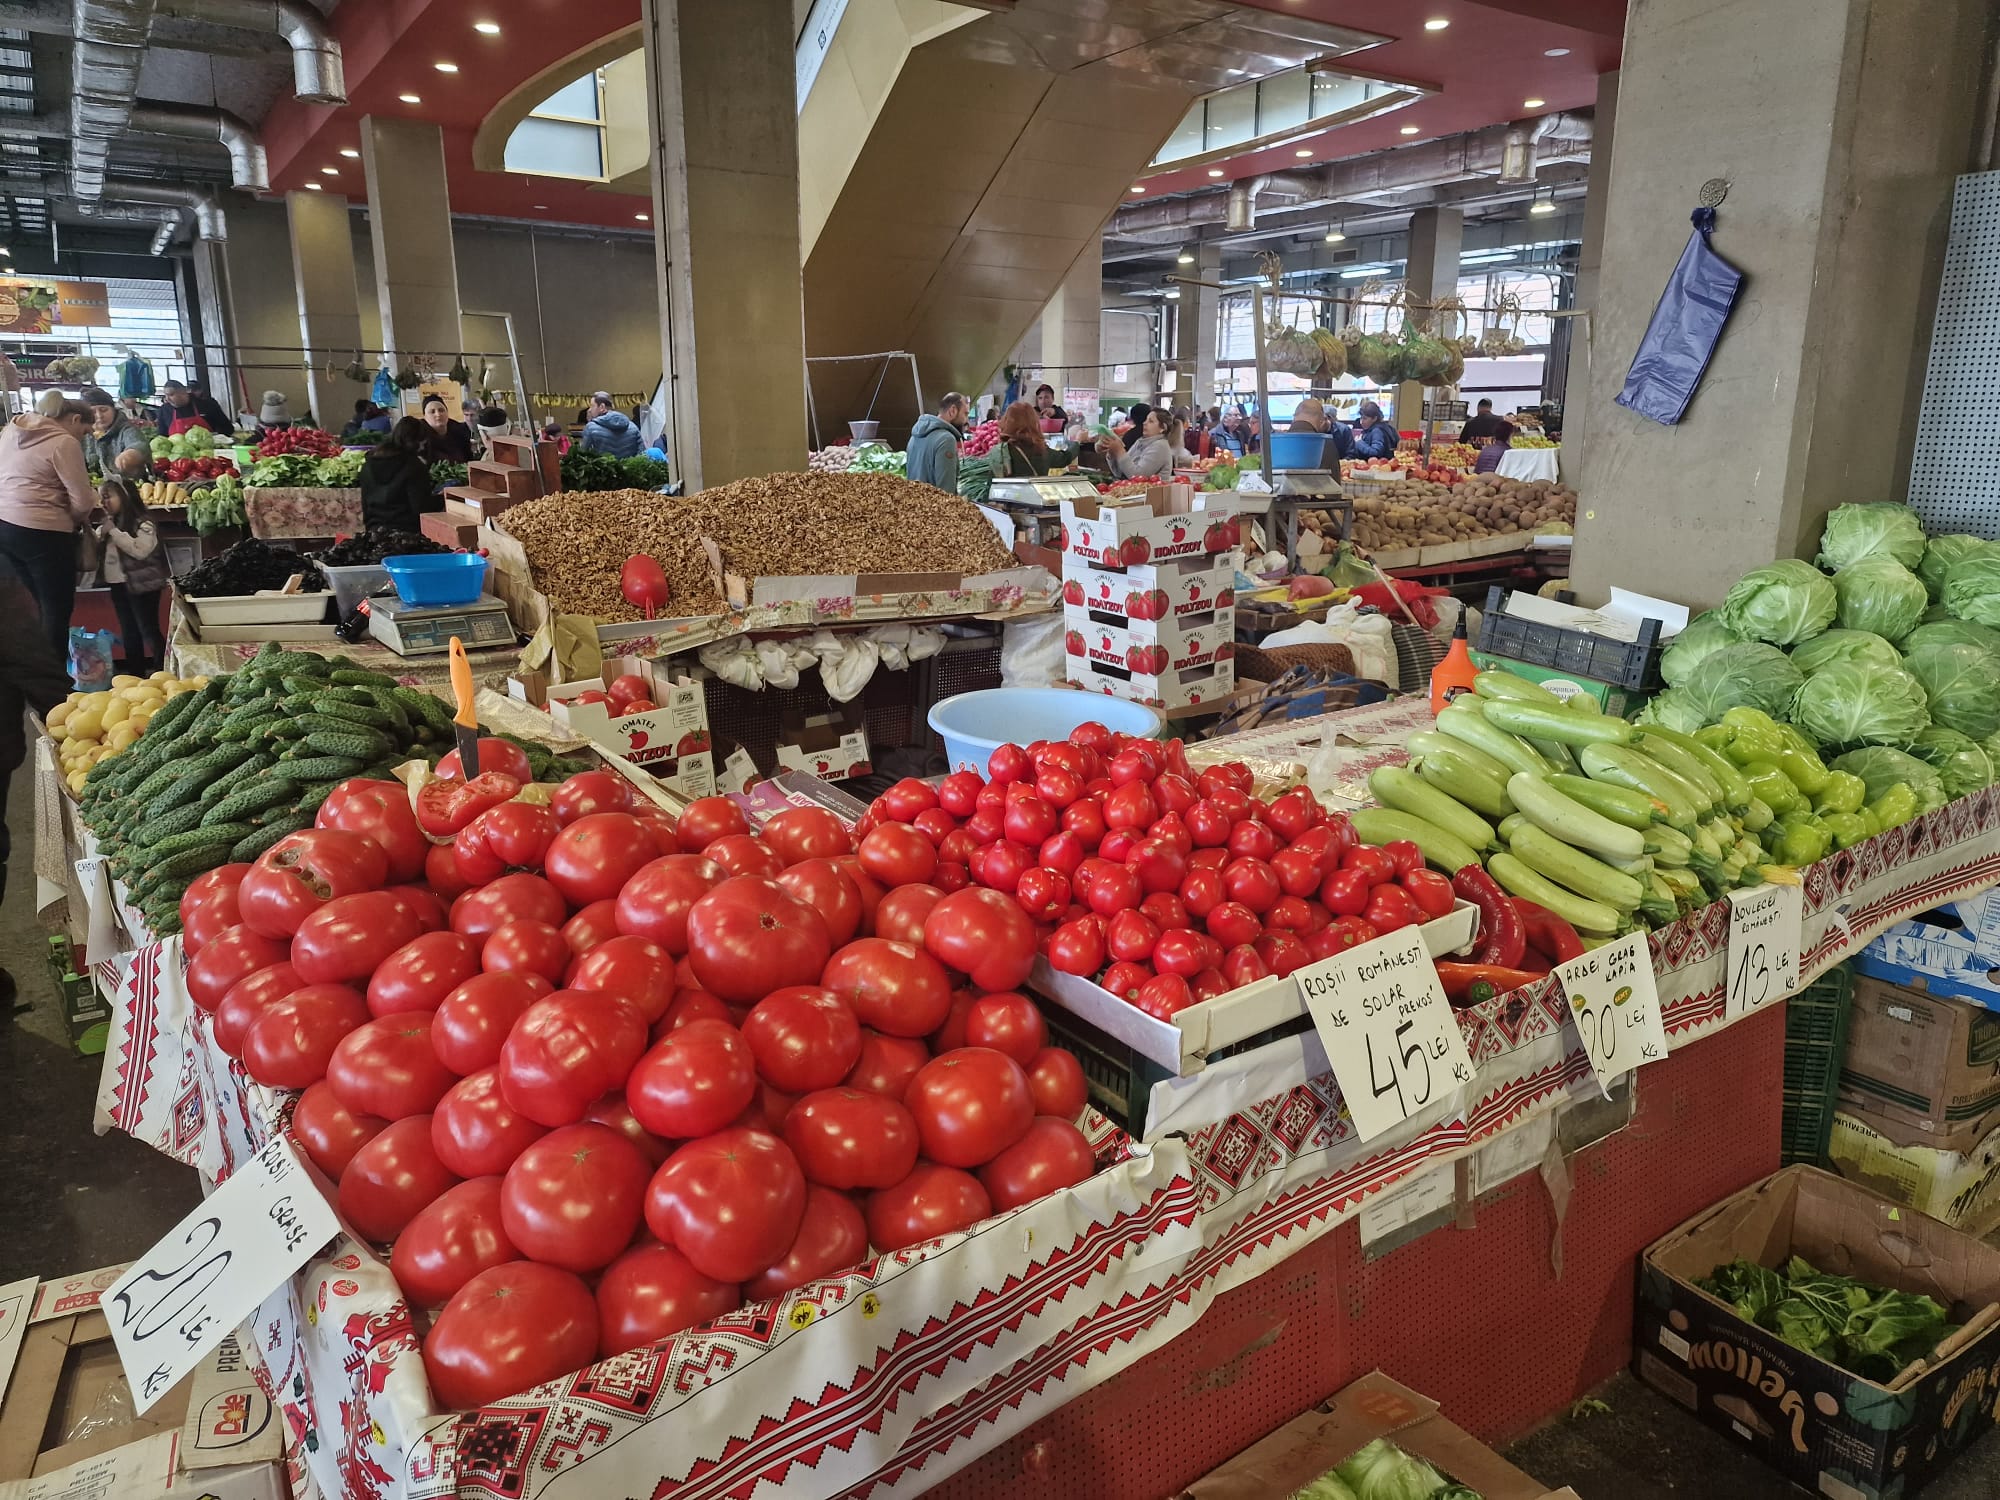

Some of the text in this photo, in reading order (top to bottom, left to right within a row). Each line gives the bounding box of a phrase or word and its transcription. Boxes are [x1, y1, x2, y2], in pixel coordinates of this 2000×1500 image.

[1154, 540, 1202, 558] ΠΟΛΥΖΟΥ
[1174, 598, 1213, 616] POLYZOU
[617, 718, 657, 735] ΤΟΜΑΤΕΣ
[619, 744, 673, 764] ΛΥΖΟΥ
[1732, 943, 1770, 1012] 13
[1785, 976, 1795, 992] KG
[1331, 984, 1406, 1028] DE SOLAR
[1581, 1004, 1616, 1077] 20
[1641, 1042, 1658, 1059] KG
[1365, 1019, 1431, 1118] 45
[1452, 1062, 1470, 1083] KG
[113, 1217, 233, 1341] 20
[143, 1362, 173, 1399] KG
[213, 1394, 246, 1435] Dole
